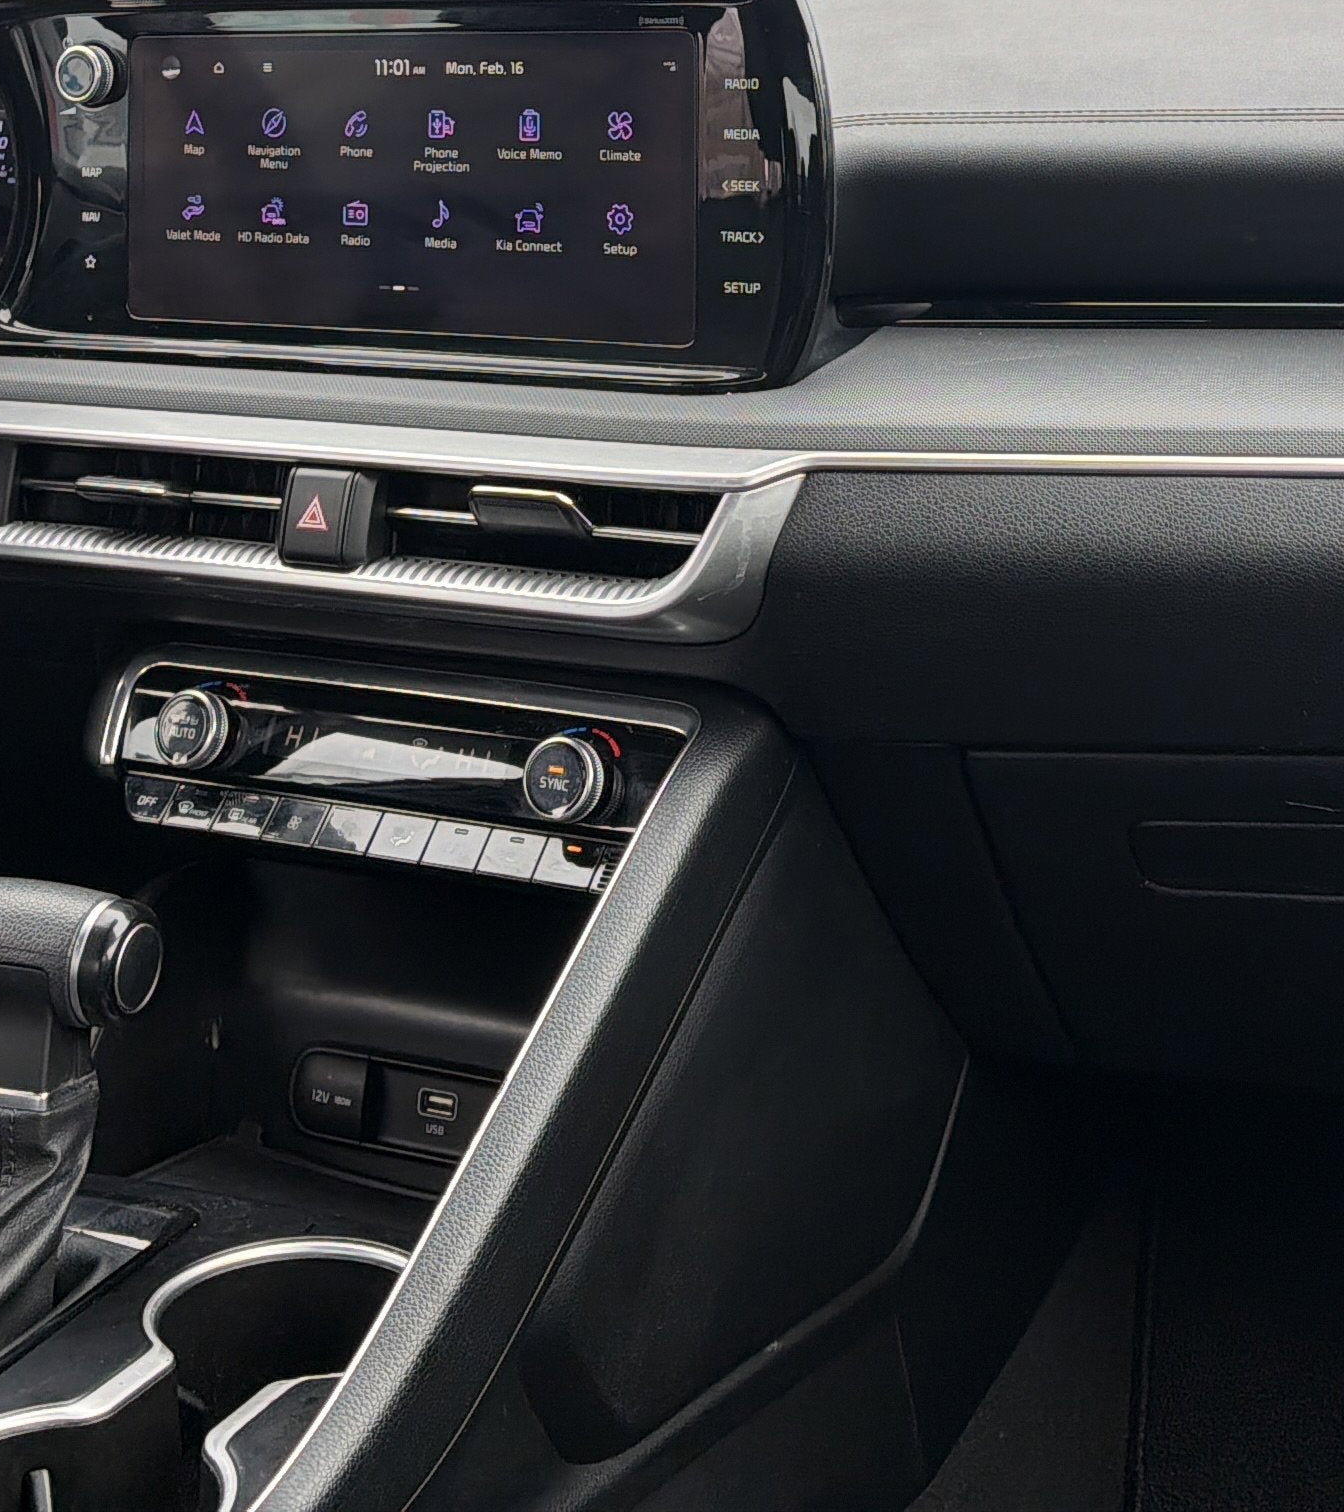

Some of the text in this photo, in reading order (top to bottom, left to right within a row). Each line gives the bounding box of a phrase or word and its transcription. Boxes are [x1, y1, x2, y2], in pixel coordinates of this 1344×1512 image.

[375, 59, 410, 76] 11:01
[511, 62, 524, 75] 16
[724, 78, 759, 90] RADIO
[723, 129, 760, 140] MEDIA
[184, 144, 205, 156] Map
[248, 144, 301, 157] Navigation
[340, 145, 373, 158] Phone
[424, 147, 459, 159] Phone
[497, 148, 563, 160] Voice Memo
[599, 149, 641, 162] Climate
[260, 158, 288, 170] Menu
[413, 161, 470, 174] Projection
[82, 167, 103, 178] MAP
[82, 212, 101, 222] NAV
[166, 229, 221, 242] Valet Mode
[238, 231, 310, 244] HD Radio Data
[340, 234, 371, 246] Radio
[424, 237, 457, 249] Media
[496, 239, 562, 253] Kia Connect
[603, 243, 638, 256] Setup
[723, 282, 761, 293] SETUP
[539, 775, 570, 793] SYNC
[137, 795, 159, 807] OFF
[311, 1088, 331, 1104] 12V
[425, 1123, 445, 1136] USB
